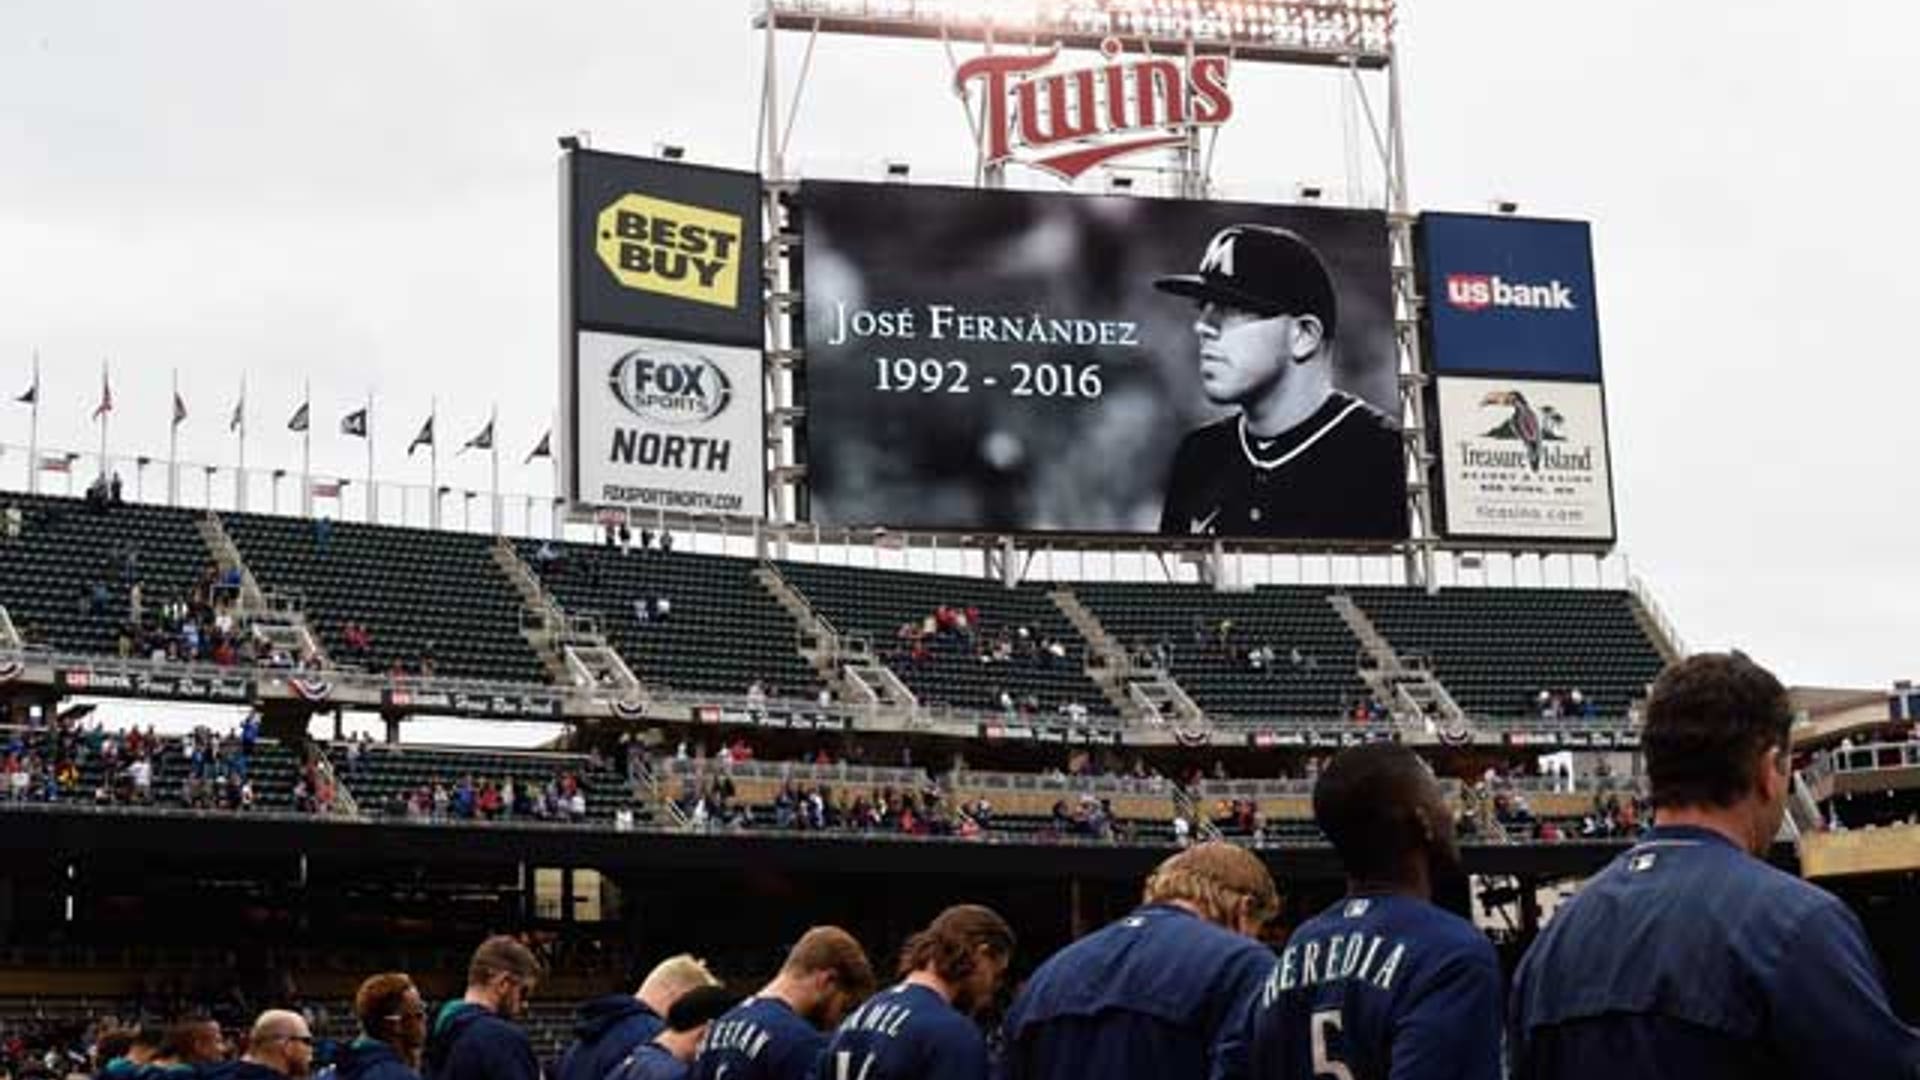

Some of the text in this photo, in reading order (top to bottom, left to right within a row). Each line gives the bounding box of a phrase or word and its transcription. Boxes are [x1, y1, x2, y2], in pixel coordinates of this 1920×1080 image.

[956, 38, 1232, 160] Twins
[616, 211, 736, 259] BEST
[621, 243, 724, 288] BUY
[636, 359, 705, 397] FOX
[875, 358, 970, 393] 1992
[1010, 363, 1102, 397] 2016
[634, 394, 708, 413] SPORTS
[611, 428, 730, 472] NORTH
